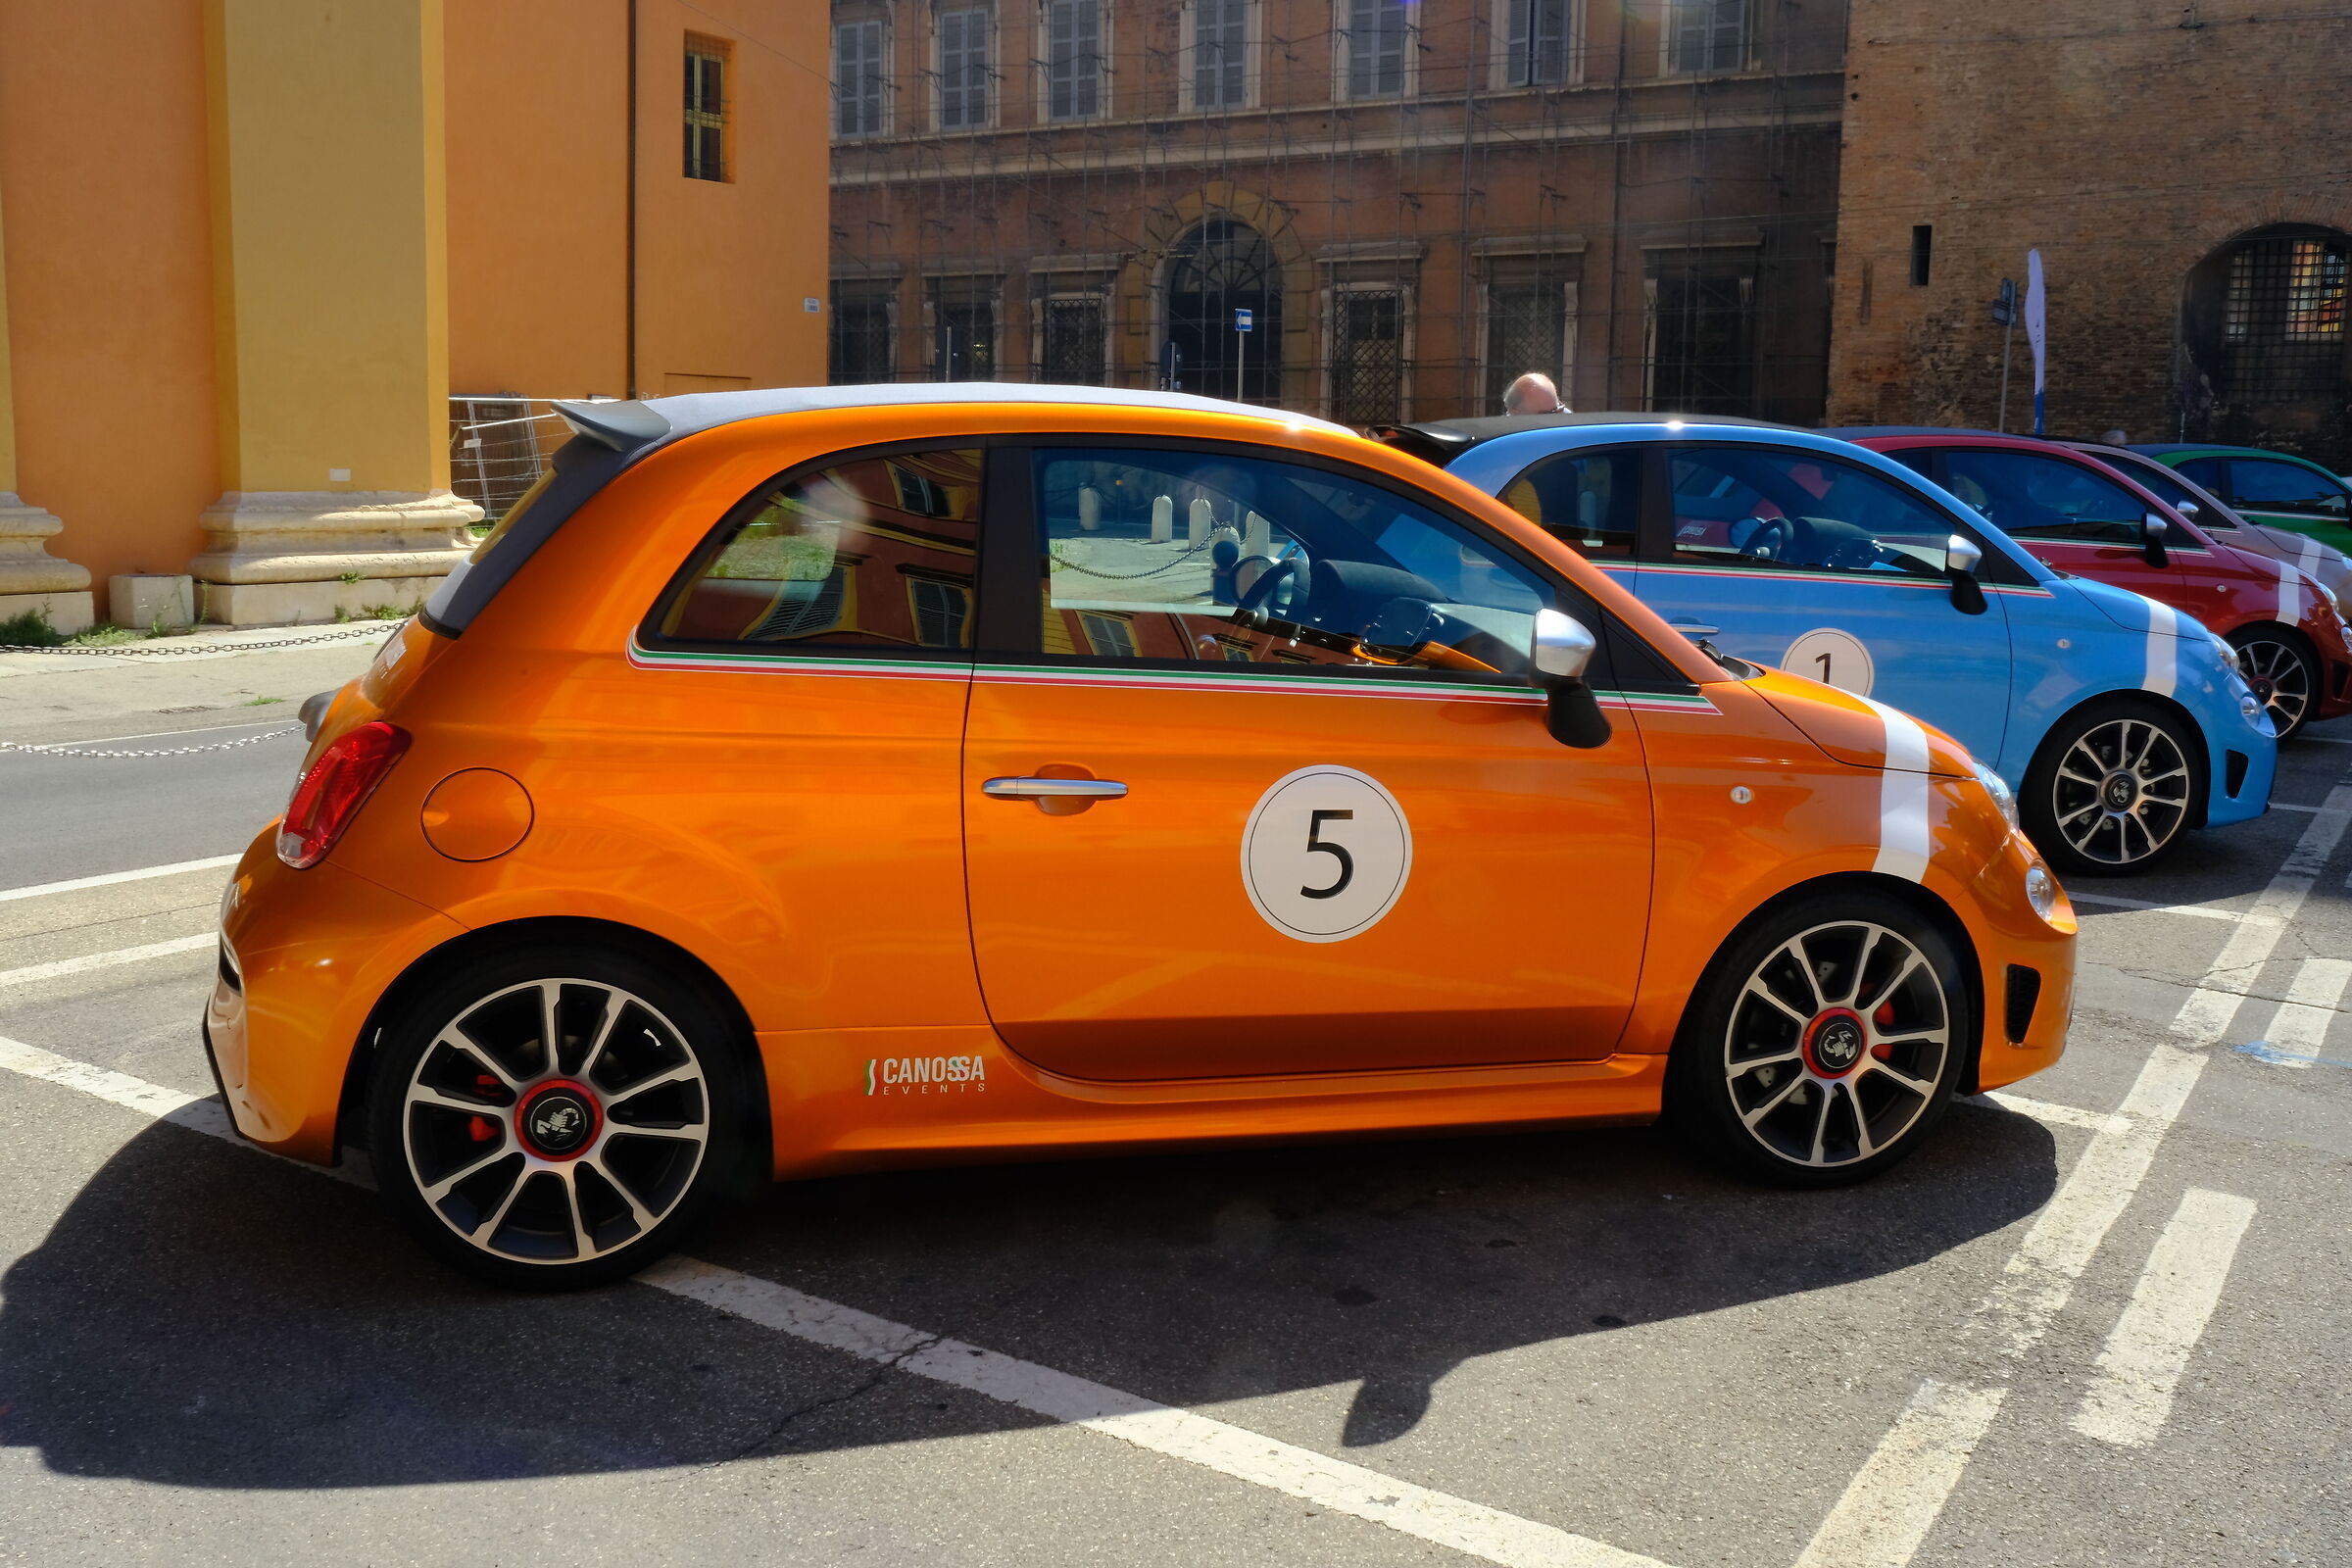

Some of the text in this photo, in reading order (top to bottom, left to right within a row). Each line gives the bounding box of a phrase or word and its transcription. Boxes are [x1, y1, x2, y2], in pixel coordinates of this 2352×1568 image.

[1815, 653, 1832, 684] 1
[1299, 808, 1354, 900] 5
[883, 1055, 985, 1084] CANOSSA
[883, 1082, 985, 1096] EVENTS
